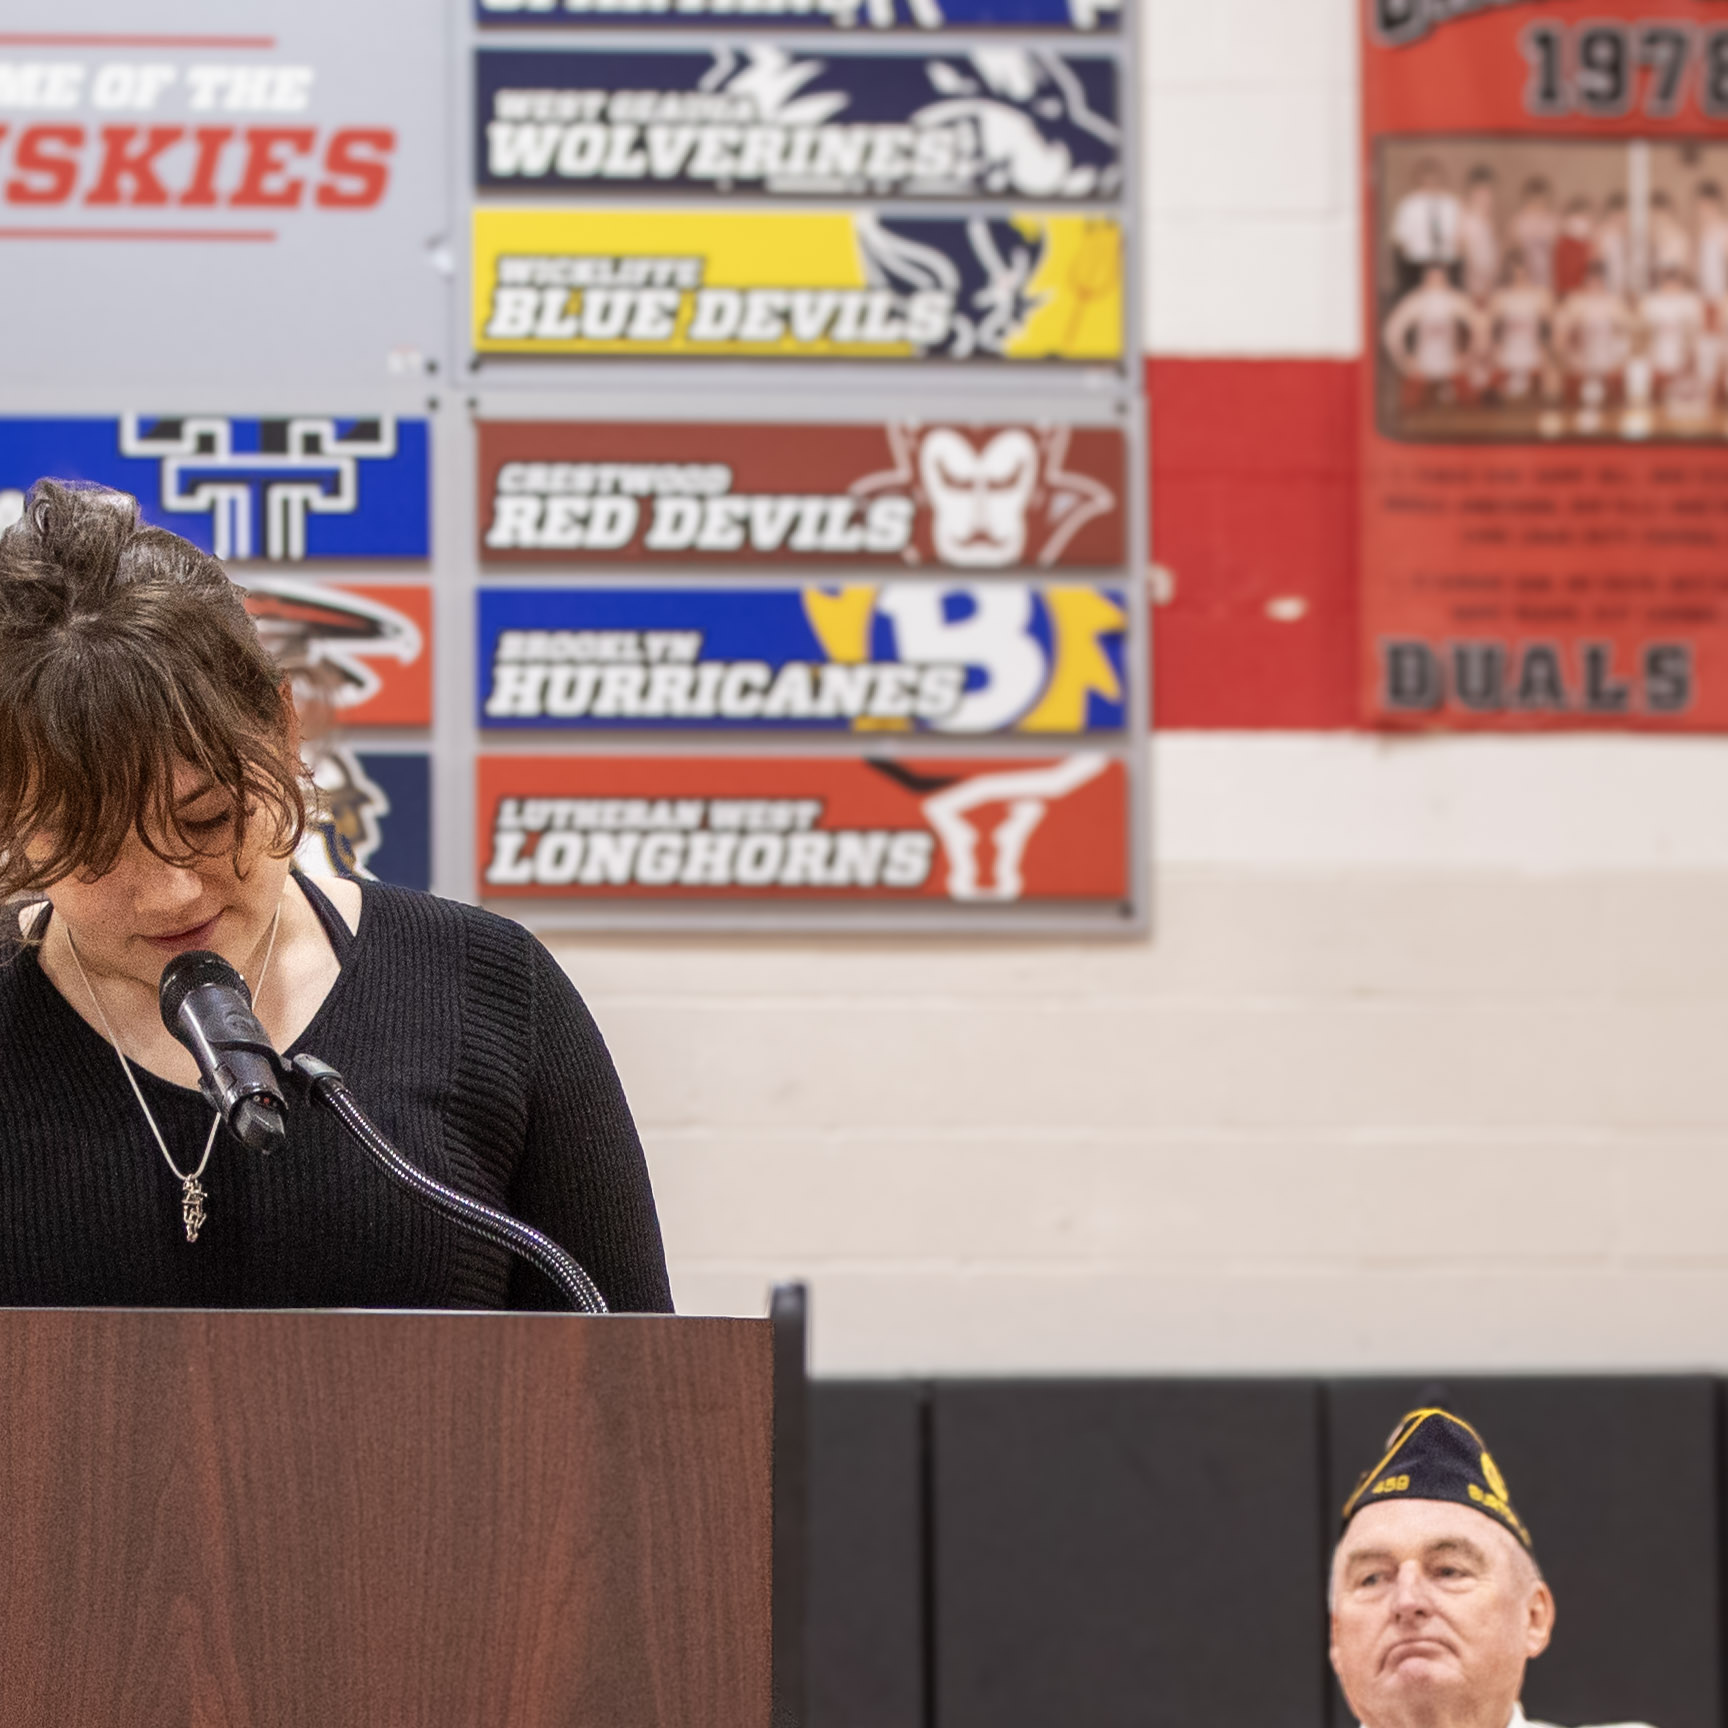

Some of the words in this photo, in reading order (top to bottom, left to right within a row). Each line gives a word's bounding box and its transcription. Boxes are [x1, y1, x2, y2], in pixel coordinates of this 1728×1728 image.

[92, 64, 176, 111] OF
[185, 65, 314, 112] THE
[498, 256, 705, 290] WICKLIFFE
[485, 289, 680, 341] BLUE
[686, 289, 957, 344] DEVILS
[485, 496, 638, 550] RED
[644, 497, 915, 553] DEVILS
[496, 631, 703, 665] BROOKLYN
[485, 664, 965, 719] HURRICANES
[1380, 637, 1694, 716] DUALS
[498, 798, 701, 832] LUTHERAN
[707, 799, 824, 833] WEST
[486, 831, 932, 886] LONGHORNS
